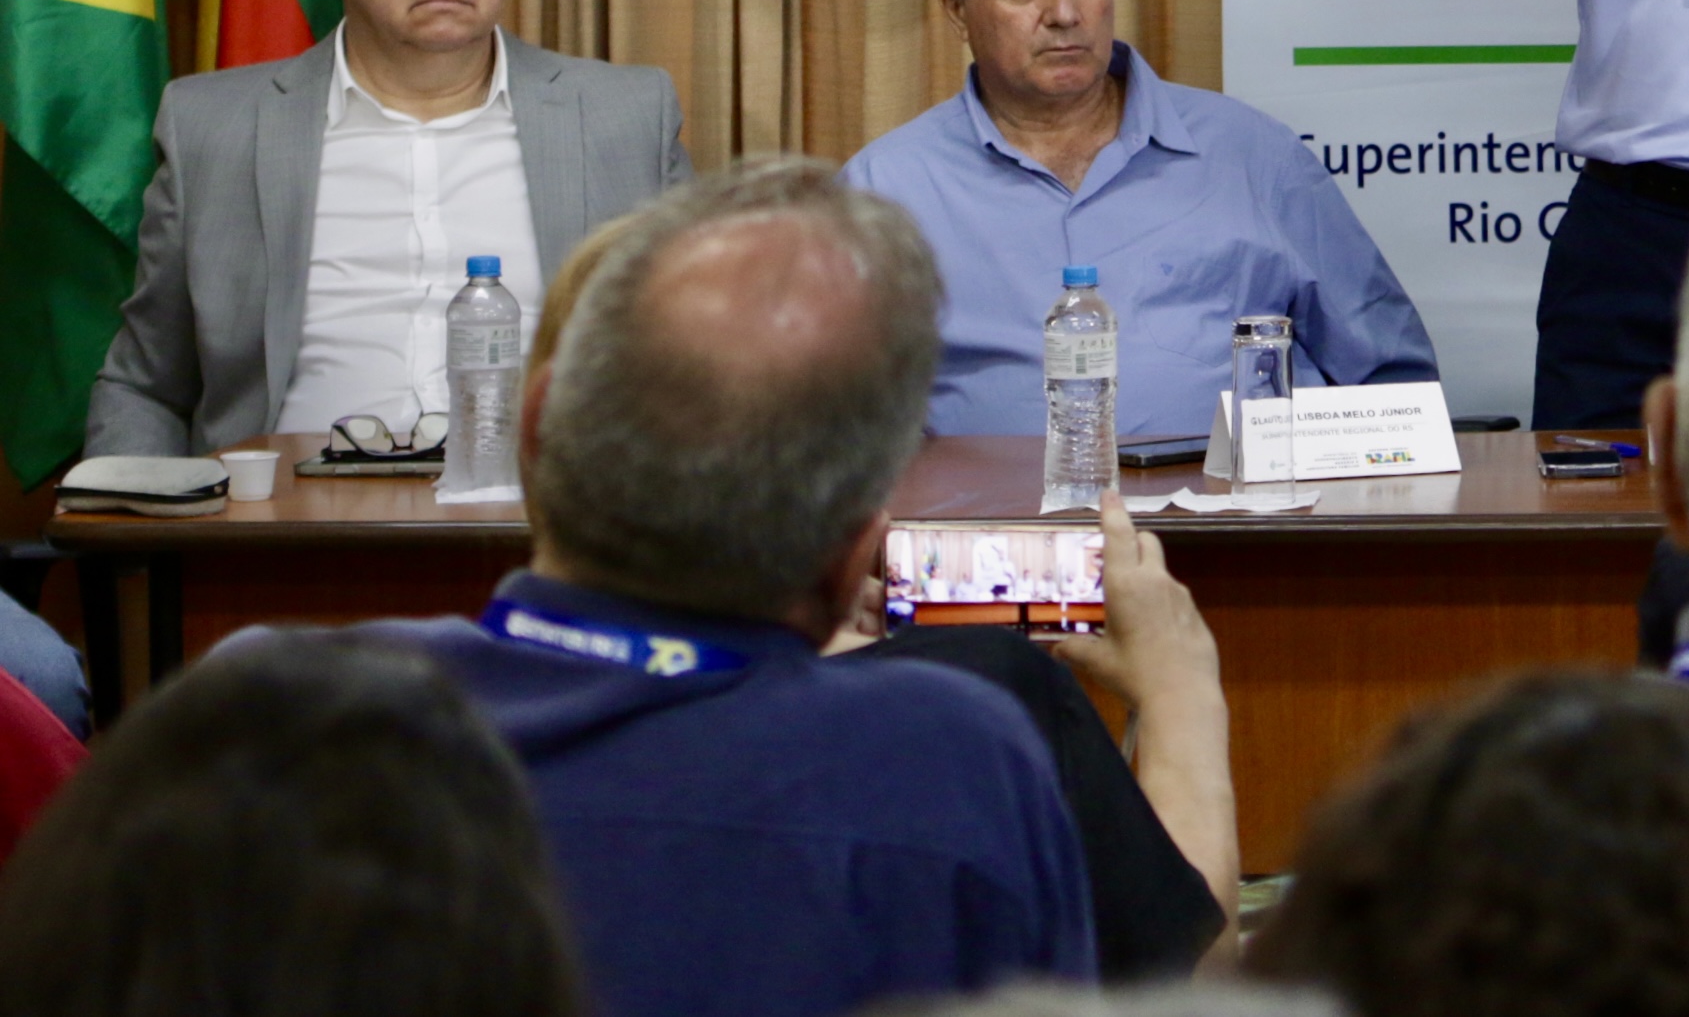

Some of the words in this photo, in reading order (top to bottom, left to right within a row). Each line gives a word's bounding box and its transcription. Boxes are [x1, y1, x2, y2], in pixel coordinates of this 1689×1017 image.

[1300, 132, 1585, 188] uperinten
[1449, 201, 1522, 243] Rio
[1297, 412, 1341, 421] LISBOA
[1343, 409, 1376, 419] MELO
